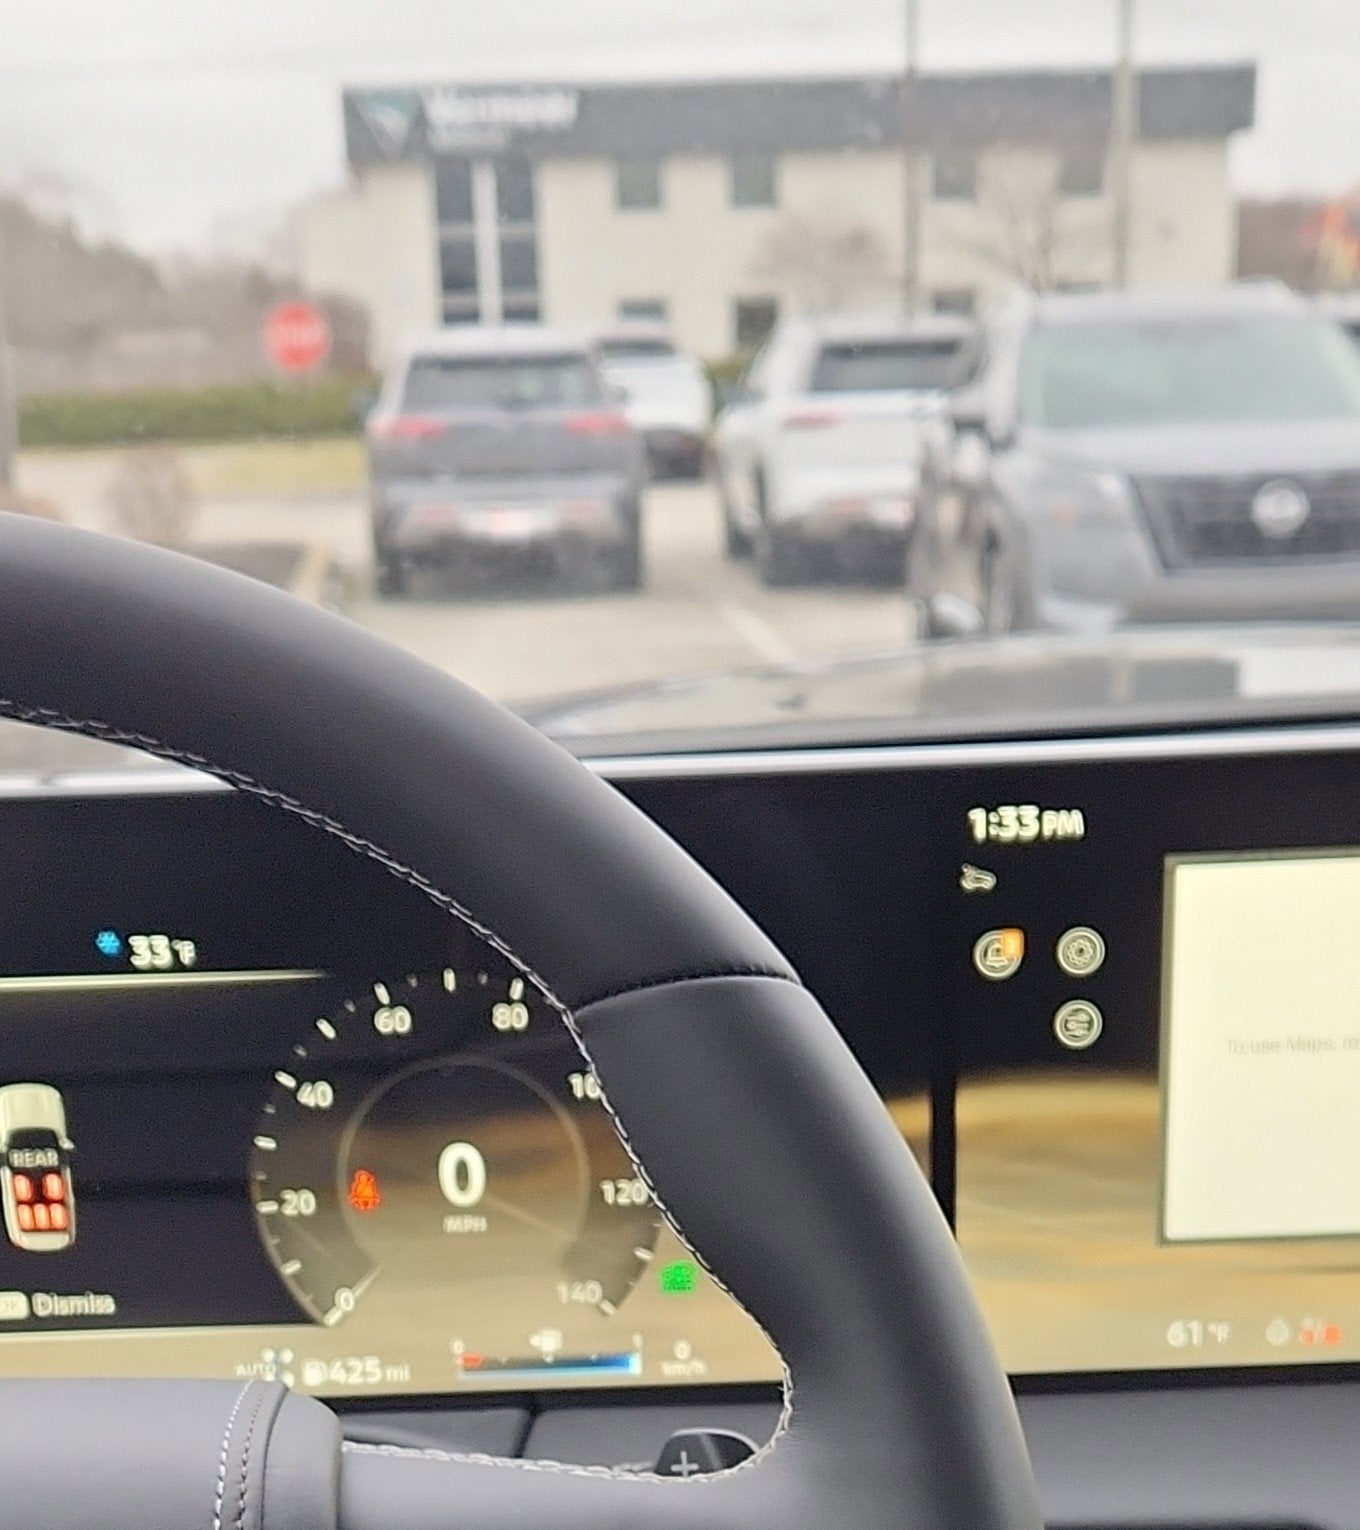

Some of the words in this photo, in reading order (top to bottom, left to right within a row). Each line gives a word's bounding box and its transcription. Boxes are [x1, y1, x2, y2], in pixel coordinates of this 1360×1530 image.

[968, 806, 1040, 842] 1:33
[1042, 809, 1085, 841] PM
[374, 1004, 413, 1035] 60
[492, 1001, 529, 1033] 80
[296, 1080, 335, 1109] 40
[9, 1149, 59, 1168] REAR
[438, 1141, 486, 1208] 0
[280, 1188, 316, 1216] 20
[600, 1178, 649, 1206] 120
[32, 1291, 117, 1318] Dismiss
[329, 1354, 383, 1385] 425
